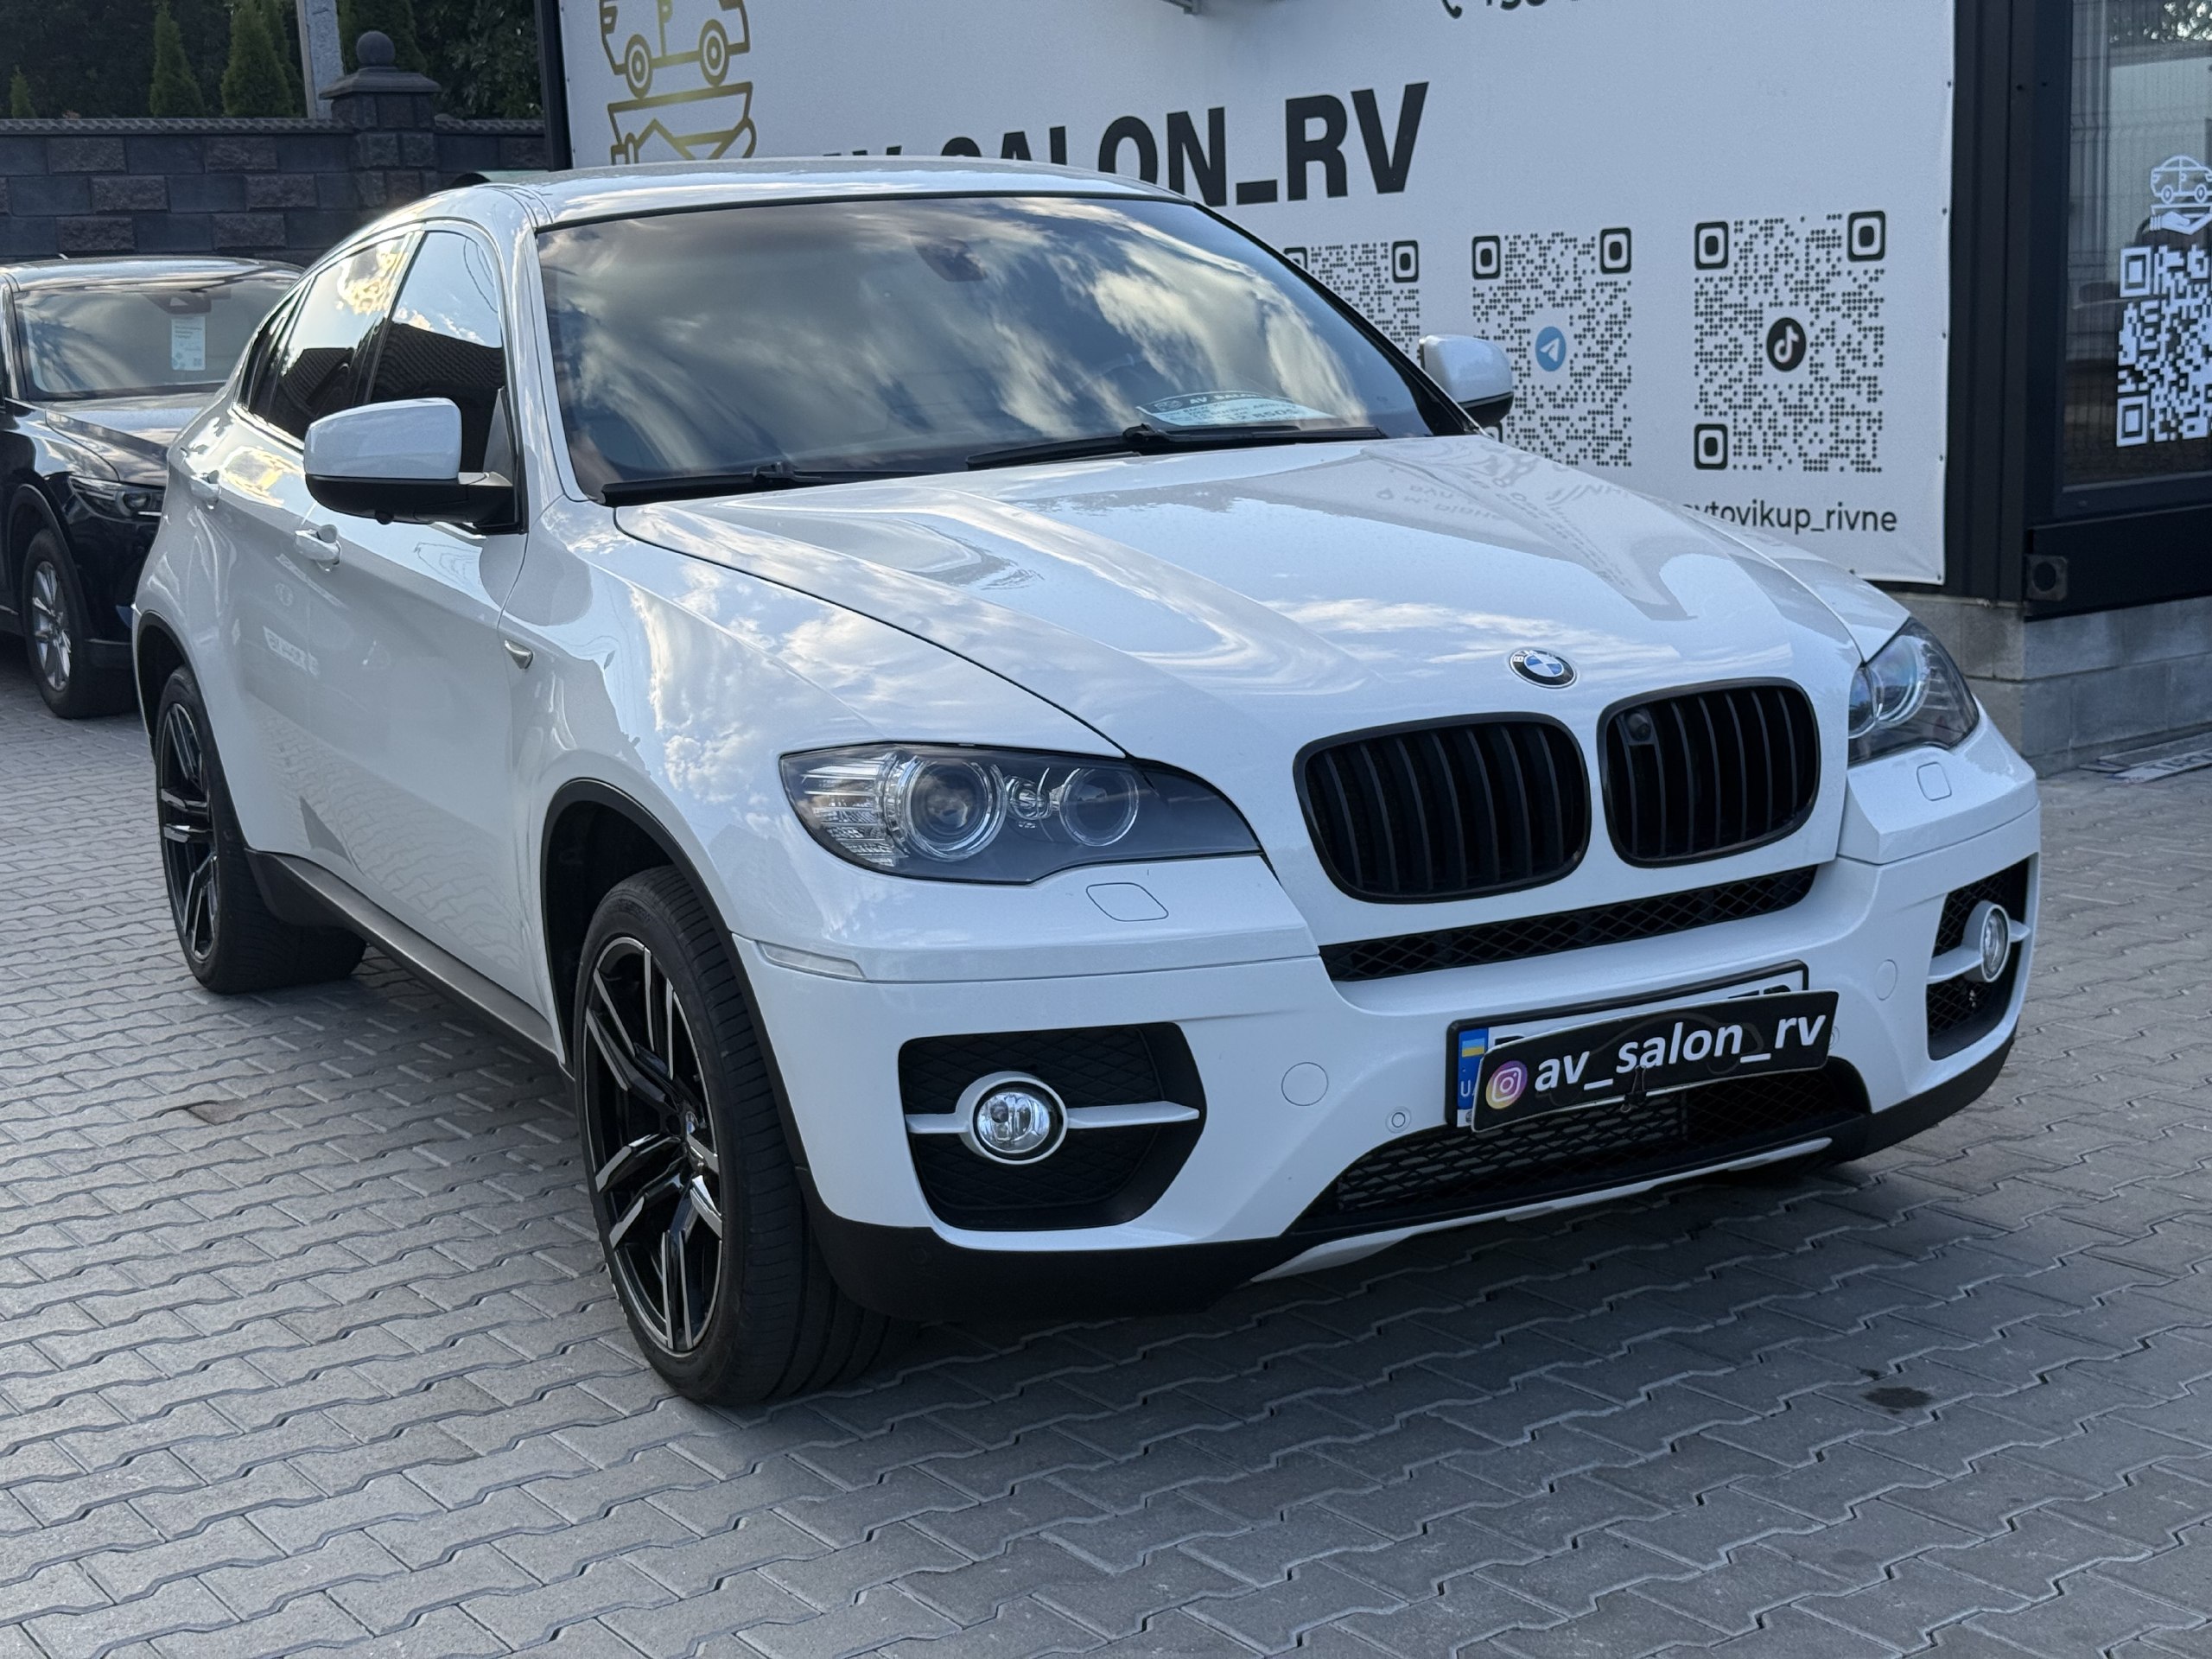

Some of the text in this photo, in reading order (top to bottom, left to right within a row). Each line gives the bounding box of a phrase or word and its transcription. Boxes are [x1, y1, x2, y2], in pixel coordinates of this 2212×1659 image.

[941, 82, 1429, 207] ON_RV
[1682, 499, 1897, 535] tovikup_rivne
[1535, 1014, 1827, 1093] av_salon_rv
[1460, 1079, 1475, 1097] U
